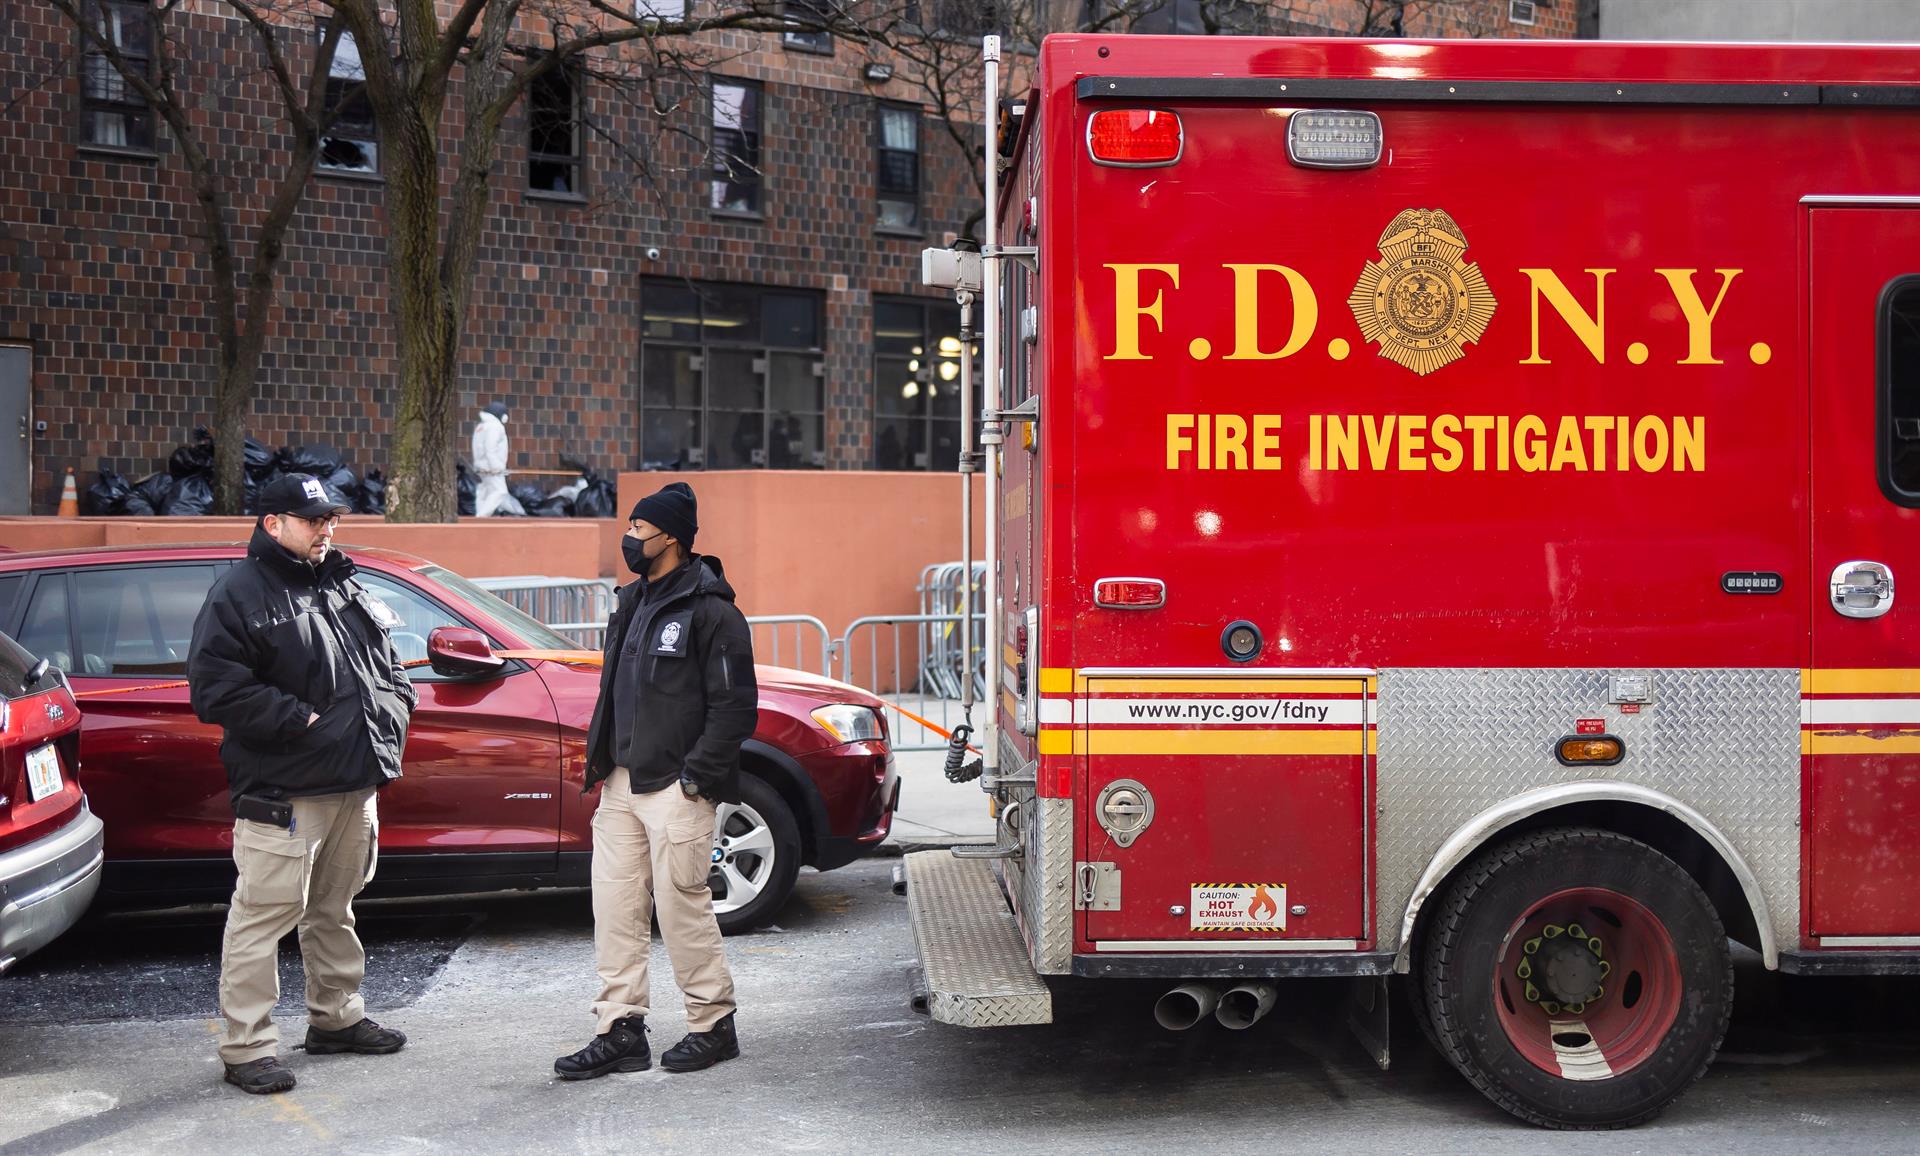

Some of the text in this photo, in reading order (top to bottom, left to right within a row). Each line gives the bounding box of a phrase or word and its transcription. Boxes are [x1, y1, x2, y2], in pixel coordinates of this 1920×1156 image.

[1416, 244, 1432, 252] BFI
[1387, 258, 1453, 280] FIRE MARSHAL
[1377, 311, 1395, 333] FIRE
[1395, 332, 1420, 348] DEPT.
[1428, 332, 1449, 346] NEW
[1451, 307, 1467, 331] YORK
[1166, 413, 1706, 472] FIRE INVESTIGATION
[1128, 699, 1329, 722] www.nyc.gov/fdny
[1199, 910, 1243, 918] EXHAUST
[1208, 901, 1234, 909] HOT
